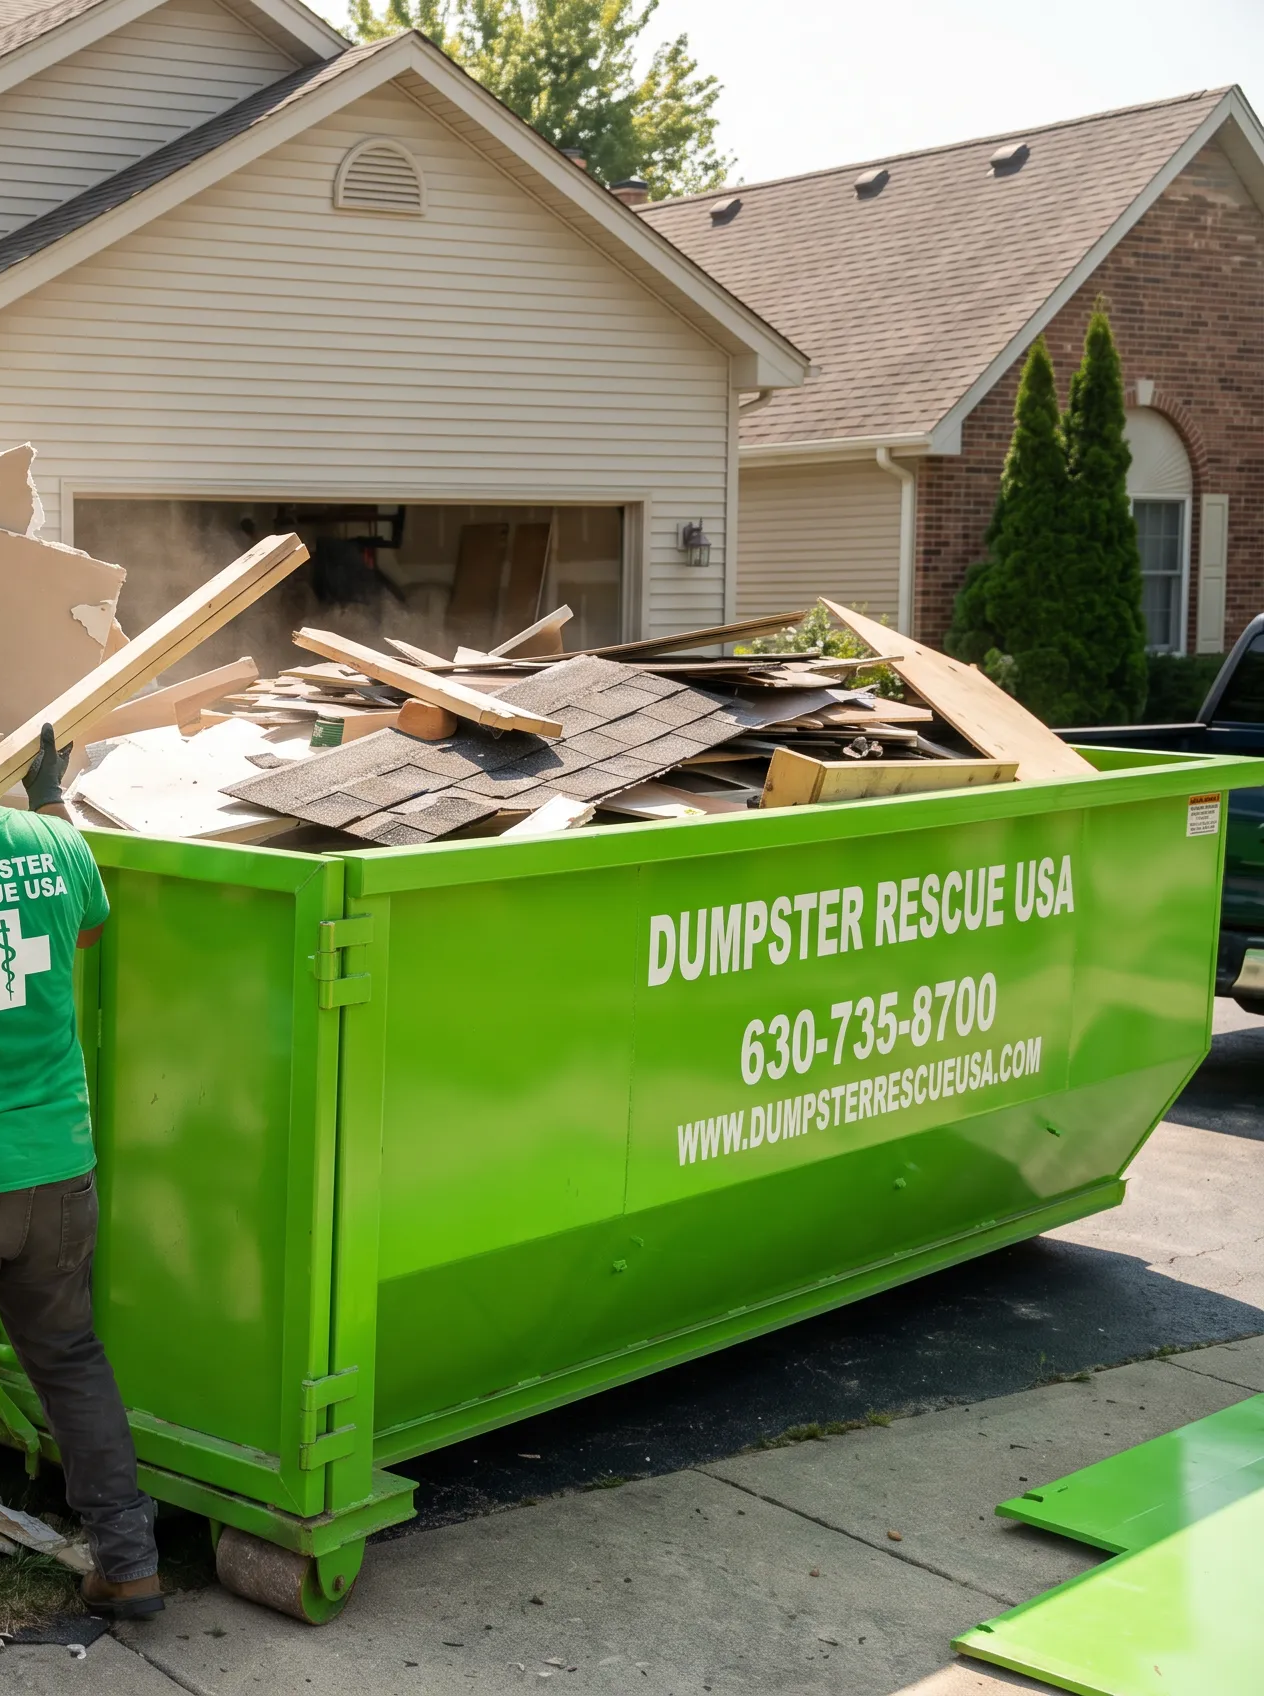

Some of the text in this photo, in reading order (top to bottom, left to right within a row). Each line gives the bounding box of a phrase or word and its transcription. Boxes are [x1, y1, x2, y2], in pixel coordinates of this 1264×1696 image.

[24, 875, 68, 899] USA
[647, 854, 1075, 987] DUMPSTER RESCUE USA
[740, 971, 997, 1085] 630-735-8700
[677, 1036, 1042, 1166] WWW.DUMPSTERRESCUEUSA.COM
